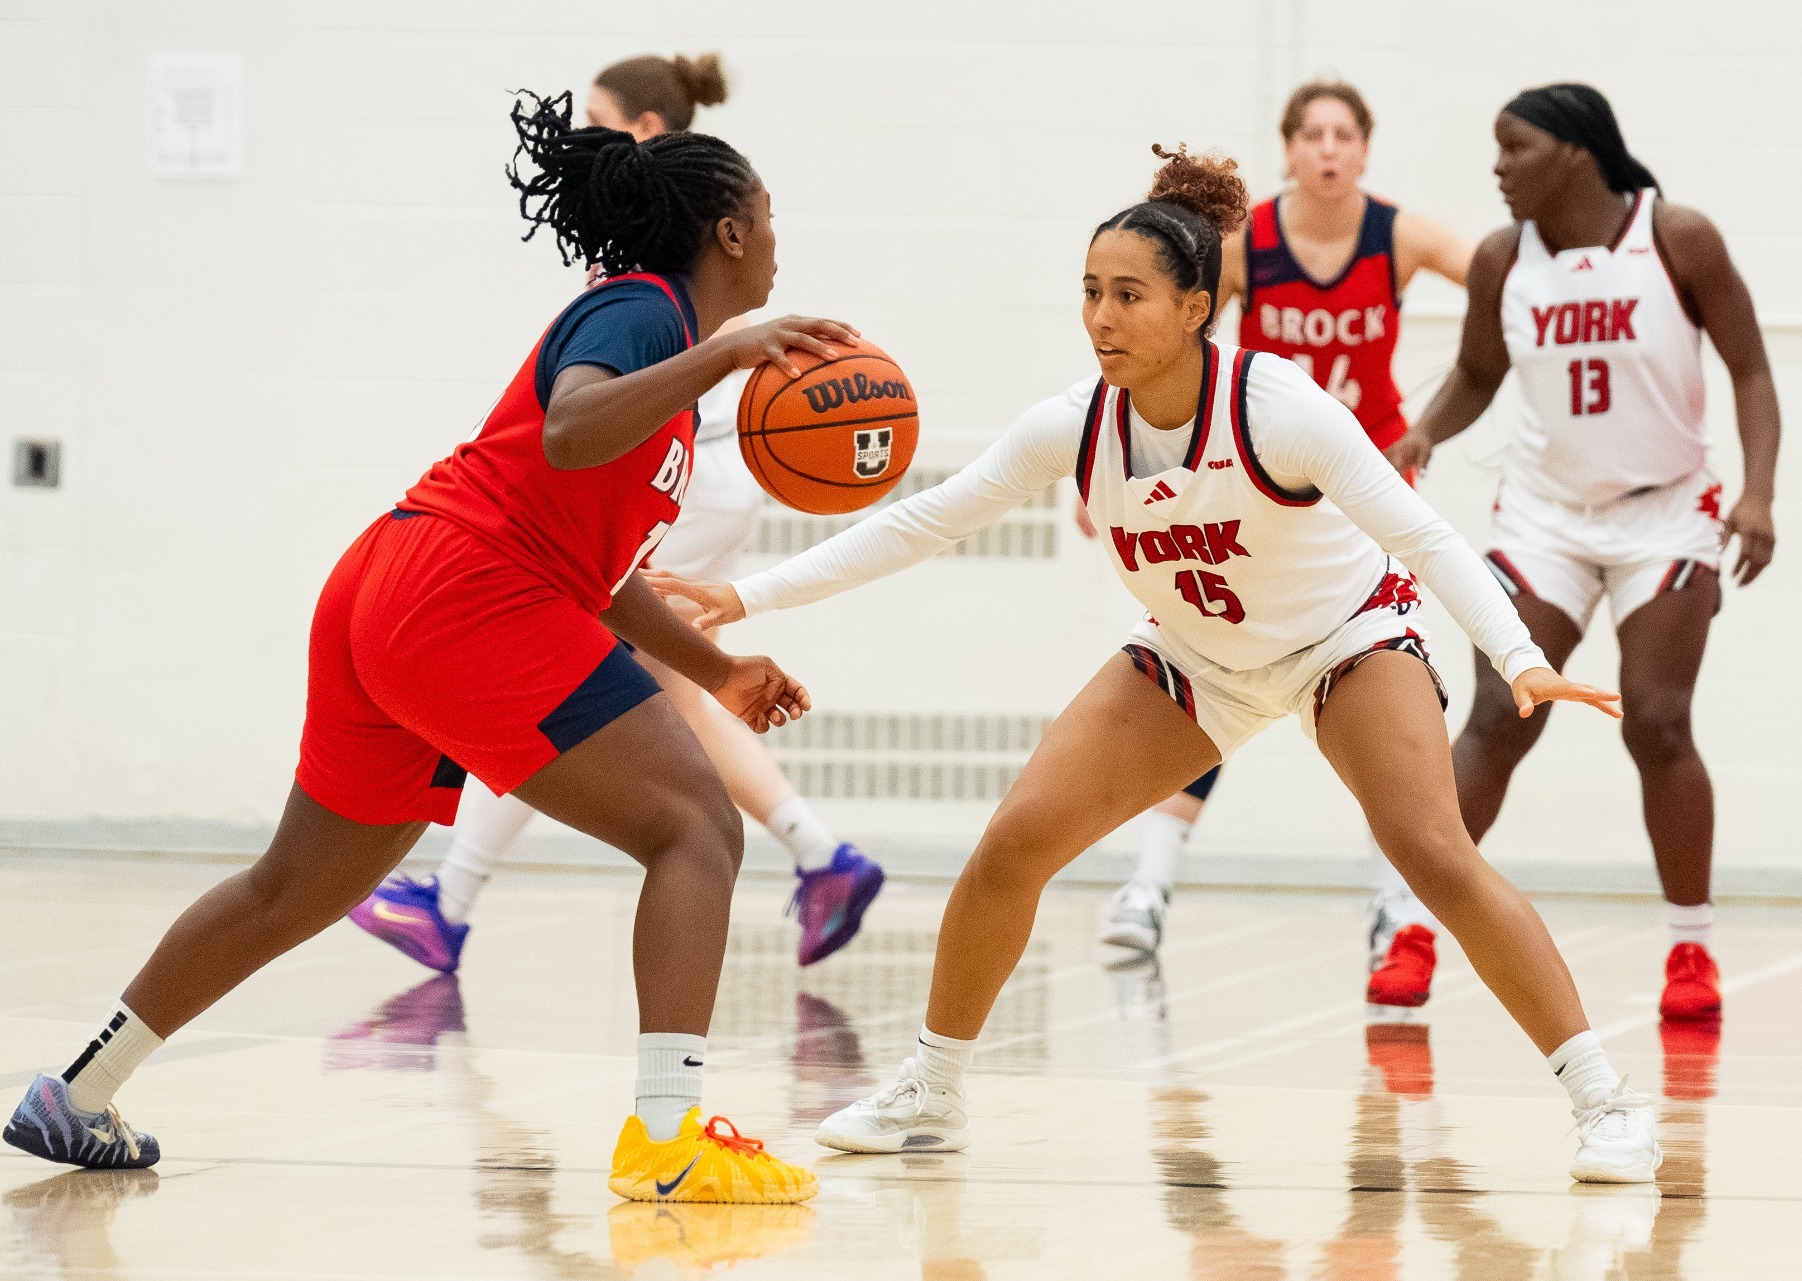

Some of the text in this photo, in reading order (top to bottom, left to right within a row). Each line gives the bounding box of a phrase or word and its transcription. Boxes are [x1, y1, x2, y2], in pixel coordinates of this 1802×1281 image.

[1259, 303, 1387, 347] BROCK
[1531, 299, 1639, 347] YORK
[802, 372, 910, 414] Wilson
[1568, 358, 1610, 415] 13
[857, 449, 889, 460] SPORTS
[1109, 519, 1252, 572] YORK
[1174, 569, 1246, 625] 15
